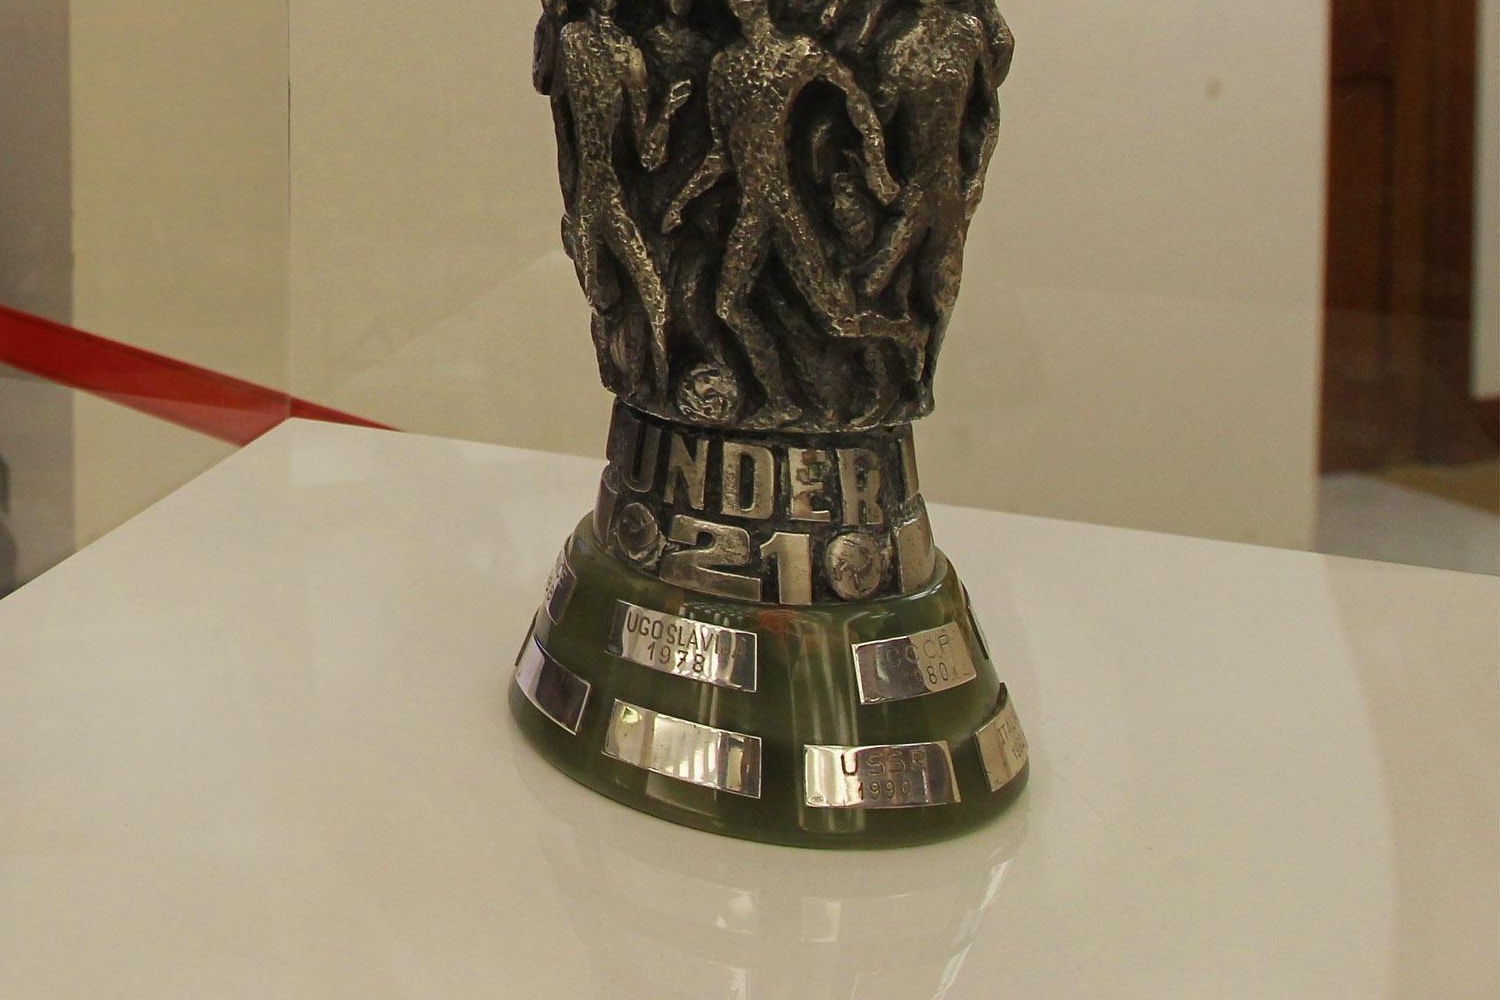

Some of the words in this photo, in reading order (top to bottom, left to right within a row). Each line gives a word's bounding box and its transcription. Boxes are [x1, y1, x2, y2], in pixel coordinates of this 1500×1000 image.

[616, 416, 884, 527] UNDER
[659, 513, 812, 606] 21
[647, 641, 706, 673] 1978
